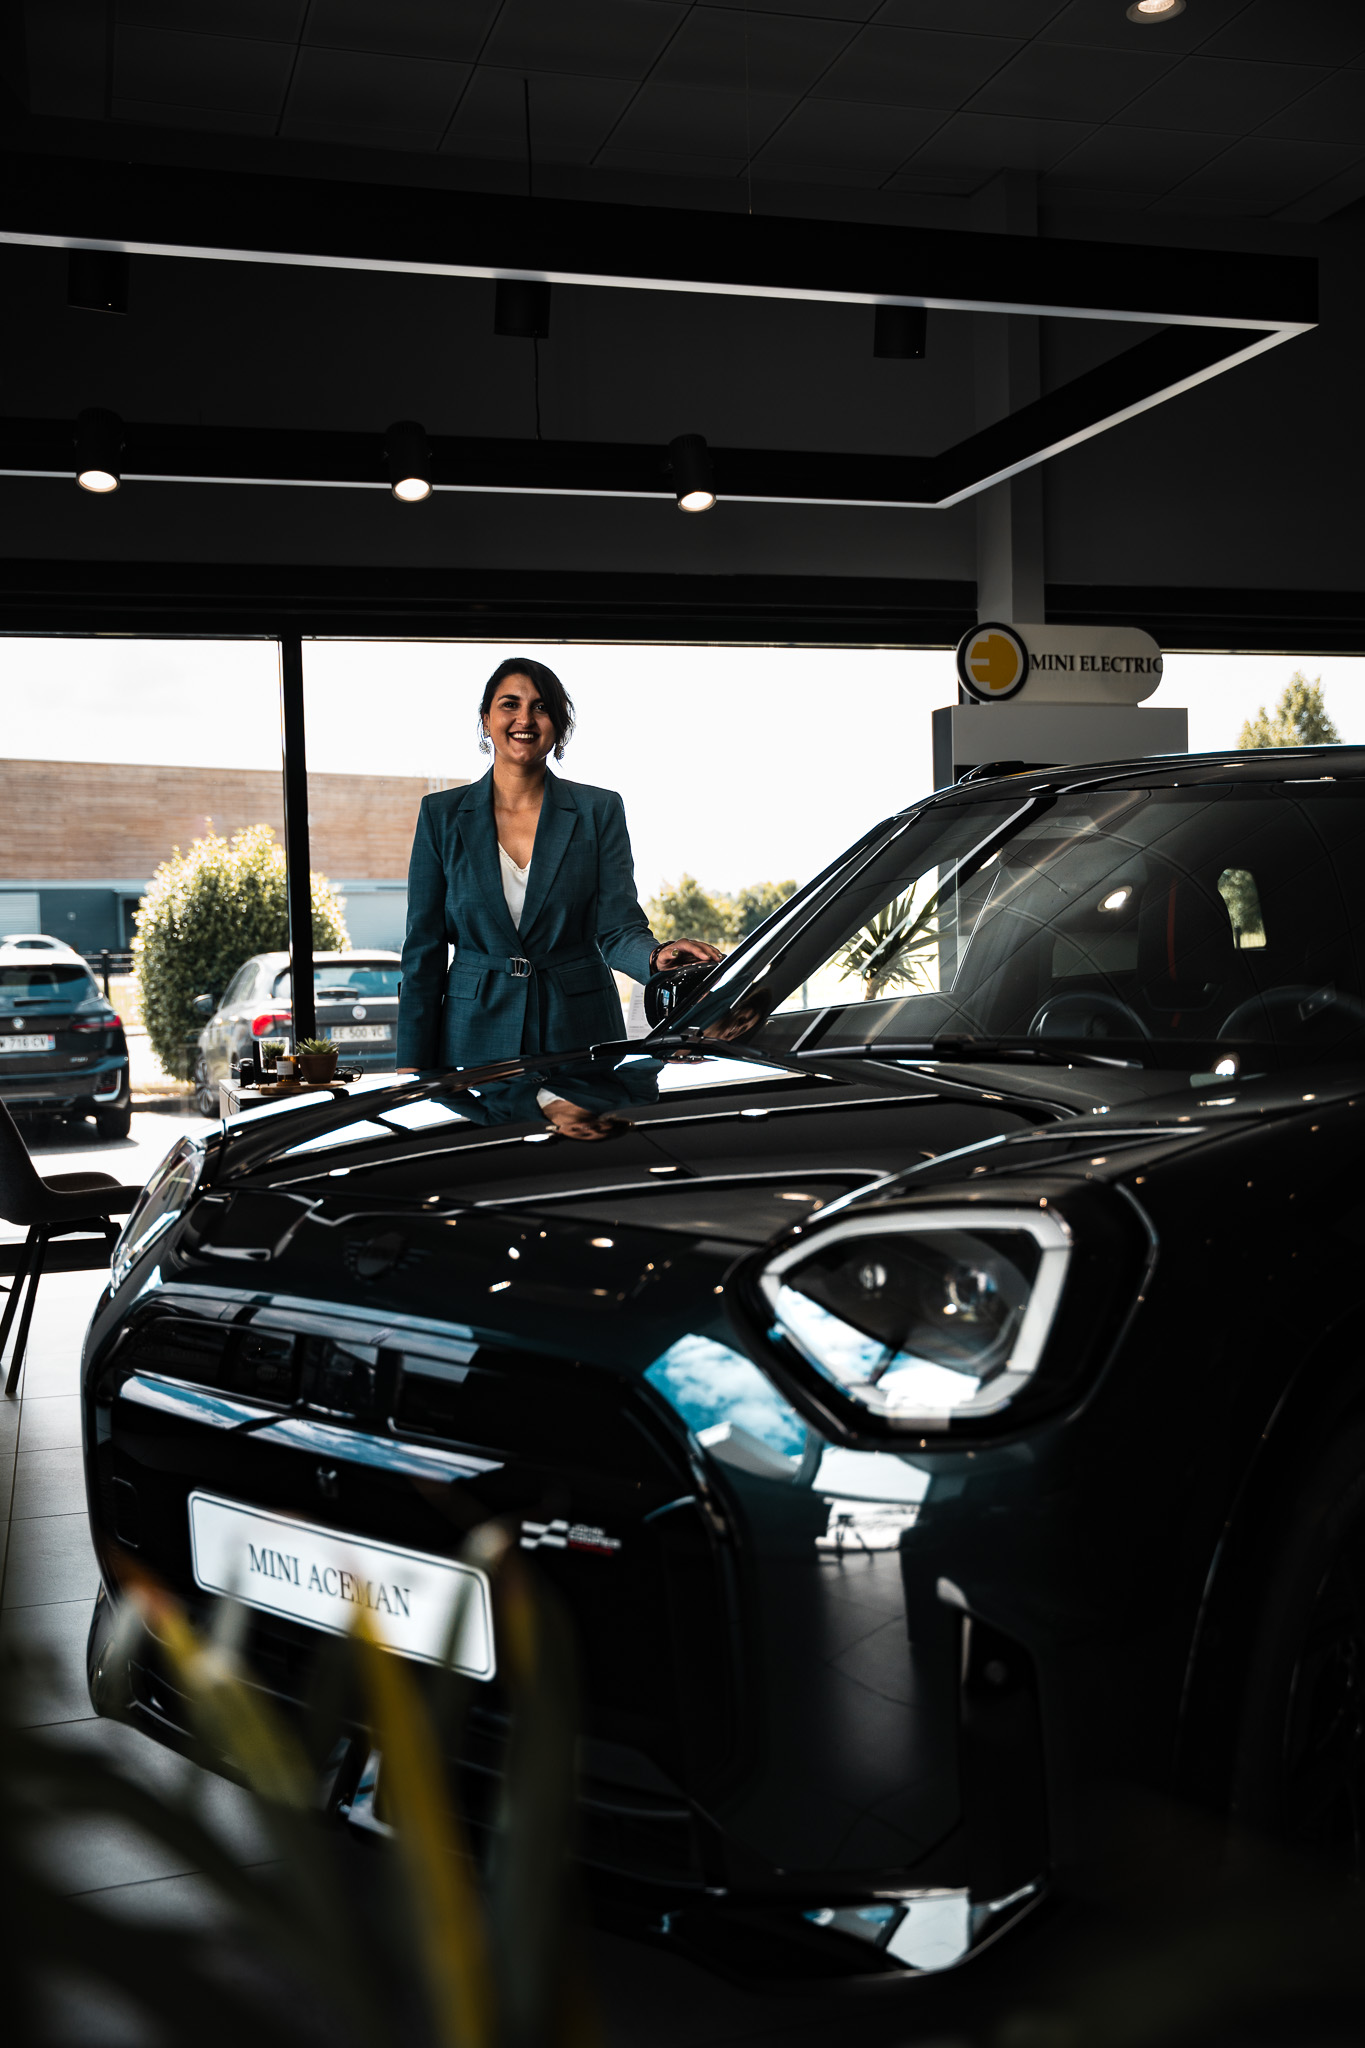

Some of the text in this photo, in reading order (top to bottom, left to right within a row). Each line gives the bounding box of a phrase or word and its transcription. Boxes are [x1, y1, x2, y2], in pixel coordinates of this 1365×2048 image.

[1030, 653, 1163, 674] MINI ELECTRIC
[248, 1542, 411, 1618] MINI ACEMAN
